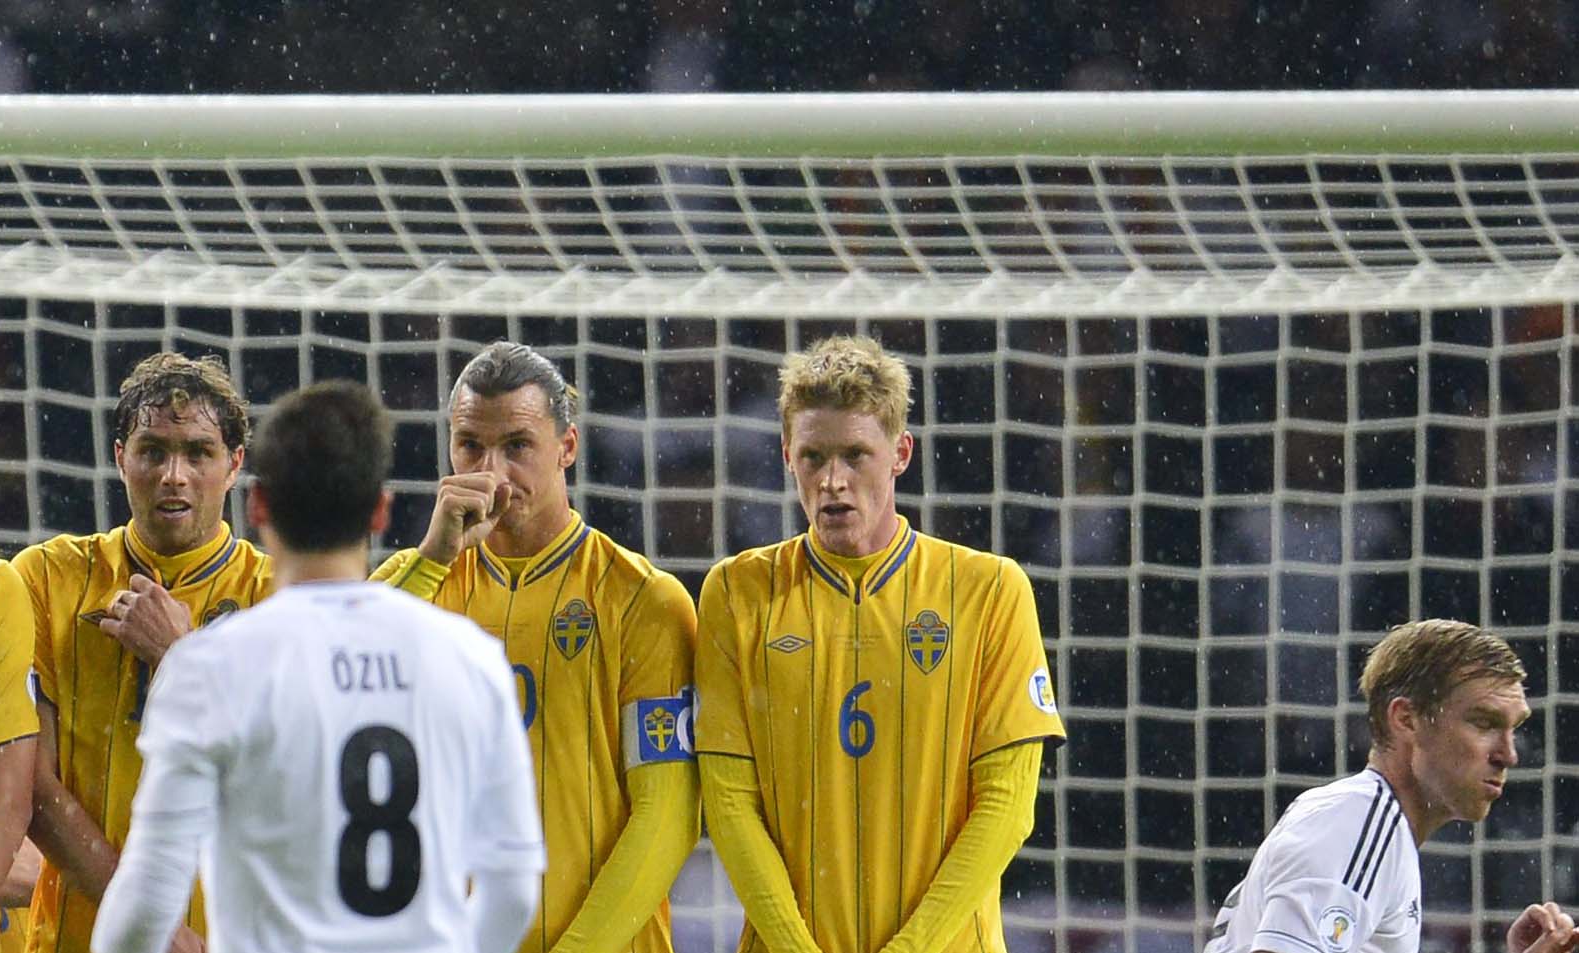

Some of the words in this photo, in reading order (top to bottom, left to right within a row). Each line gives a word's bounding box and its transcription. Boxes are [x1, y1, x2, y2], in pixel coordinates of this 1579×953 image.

[331, 645, 409, 691] ÖZIL
[838, 680, 875, 758] 6
[336, 724, 421, 917] 8
